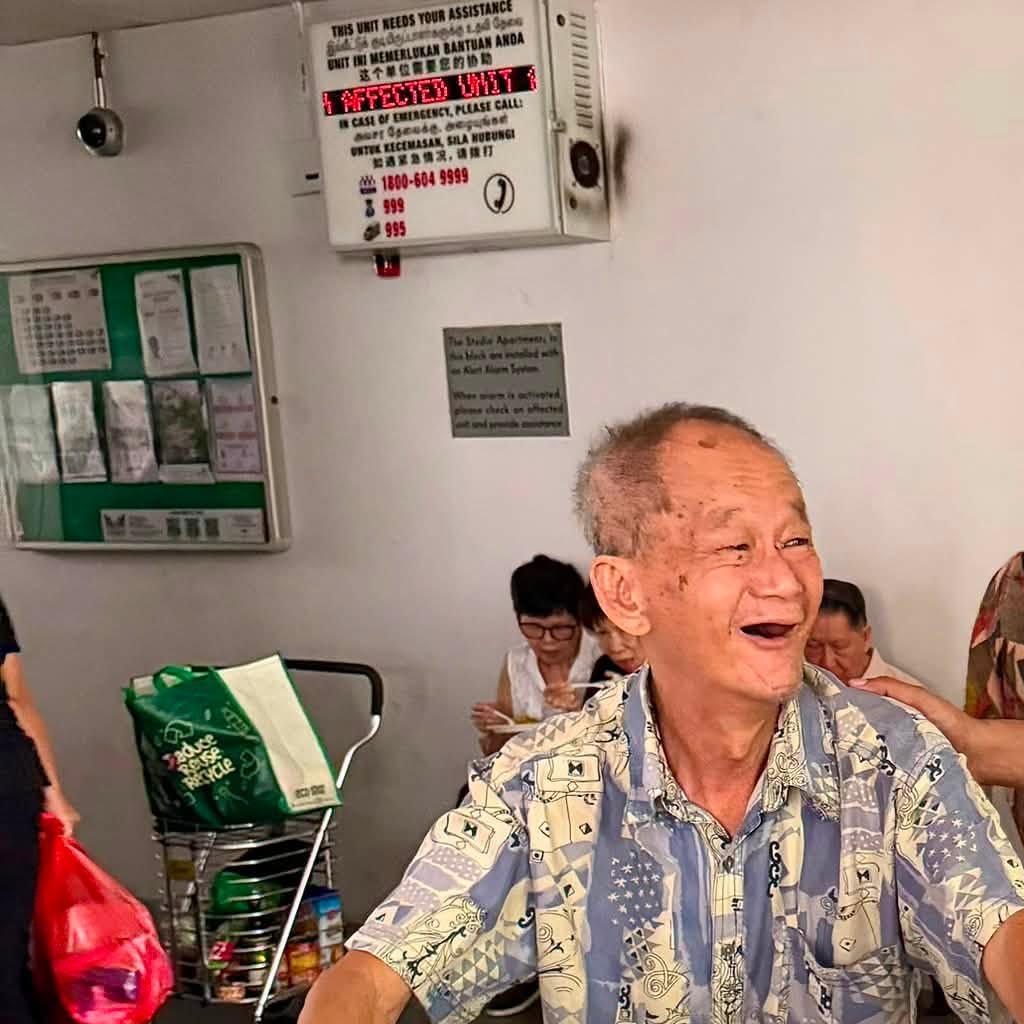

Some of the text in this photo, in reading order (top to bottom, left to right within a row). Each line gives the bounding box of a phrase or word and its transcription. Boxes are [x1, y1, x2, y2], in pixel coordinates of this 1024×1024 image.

[331, 0, 512, 38] THIS UNIT NEEDS YOUR ASSISTANCE
[328, 57, 349, 71] UNIT
[353, 54, 367, 68] INI
[370, 43, 440, 64] MEMERLUKAN
[443, 36, 492, 55] BANTUAN
[496, 32, 525, 48] ANDA
[341, 78, 448, 113] AFFECTED
[458, 69, 513, 98] UNIT
[339, 119, 349, 129] IN
[351, 115, 375, 128] CASE
[378, 113, 390, 125] OF
[393, 107, 454, 123] EMERGENCY,
[455, 101, 491, 116] PLEASE
[351, 144, 381, 157] UNTUK
[447, 133, 468, 146] SILA
[472, 129, 515, 143] HUBUNGI
[382, 168, 469, 191] 1800-604 9999
[383, 197, 404, 214] 999
[385, 221, 406, 238] 995
